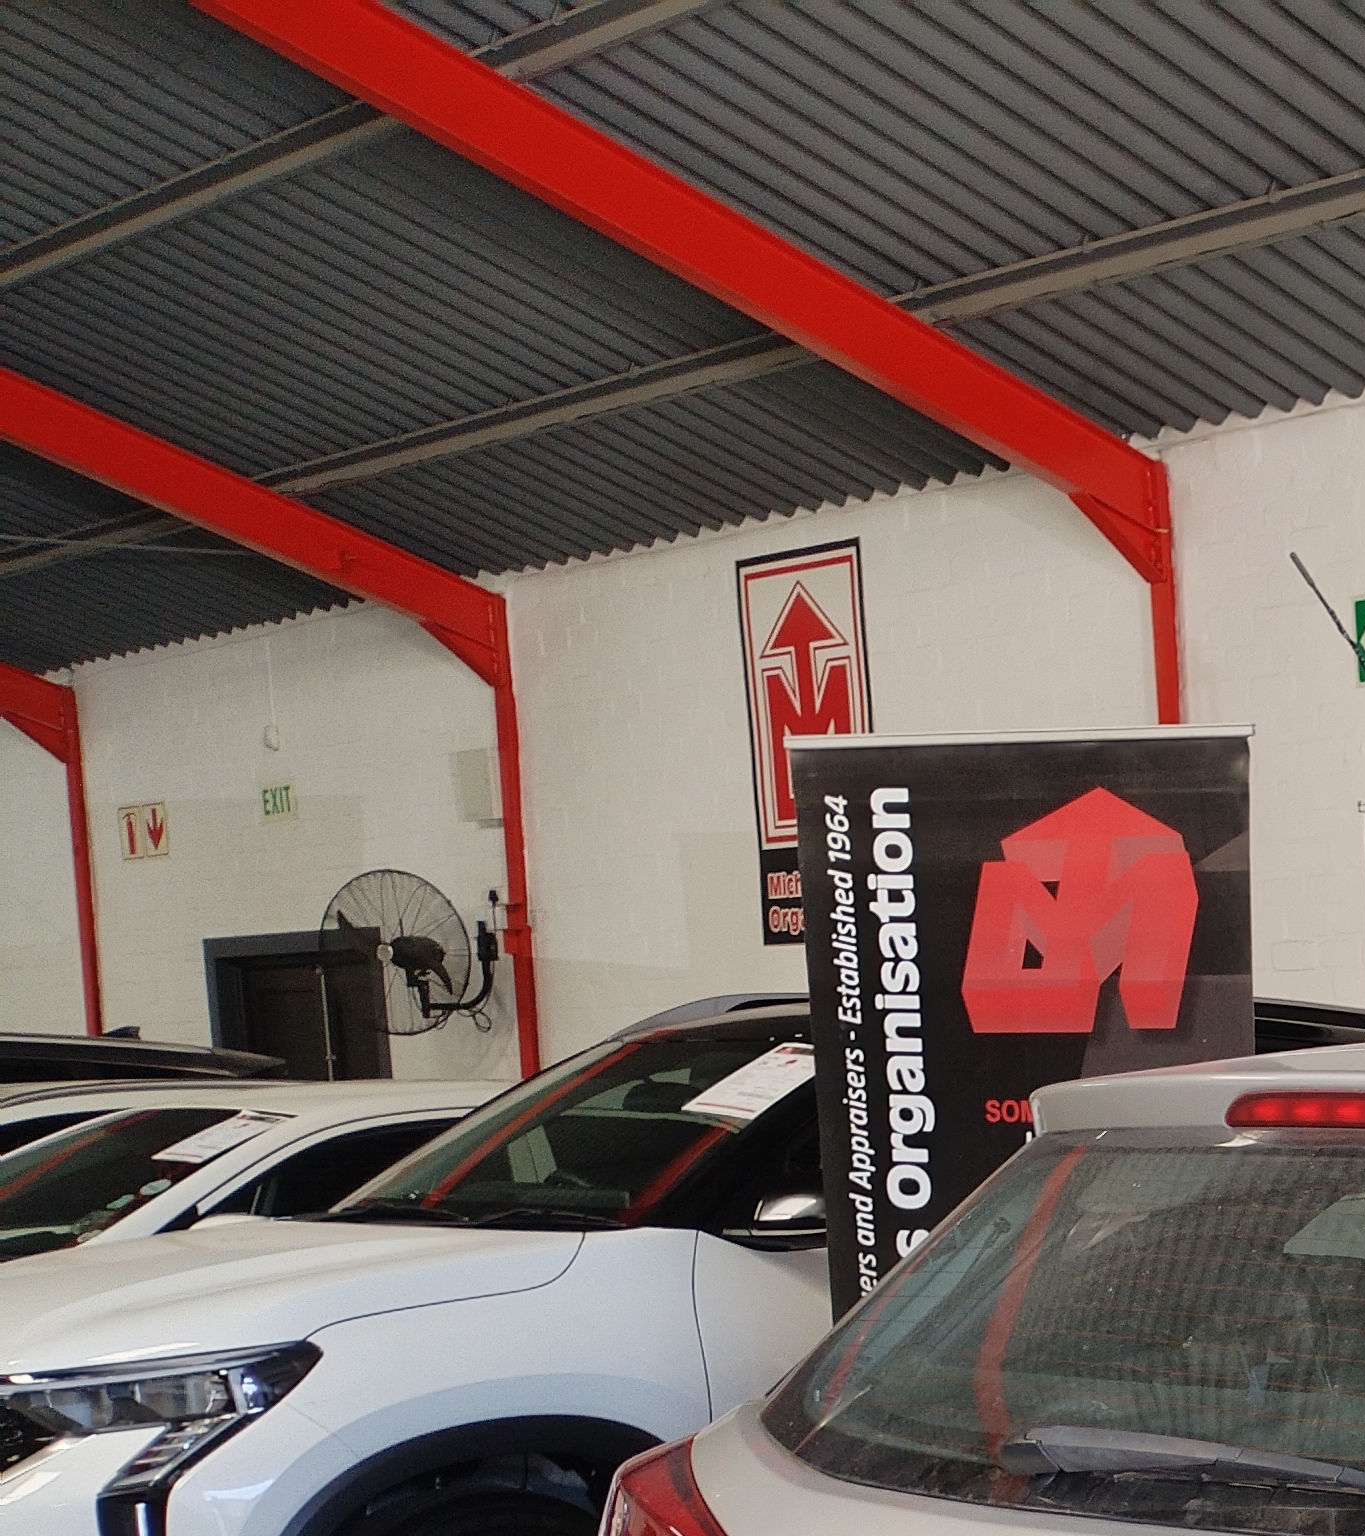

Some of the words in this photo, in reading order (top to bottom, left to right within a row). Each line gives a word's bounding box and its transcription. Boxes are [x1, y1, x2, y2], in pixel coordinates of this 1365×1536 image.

[262, 785, 291, 815] EXIT
[824, 794, 851, 862] 1964
[826, 869, 863, 1026] Established
[843, 1048, 877, 1190] Appraisers
[849, 1192, 875, 1247] and
[858, 1252, 878, 1297] ers
